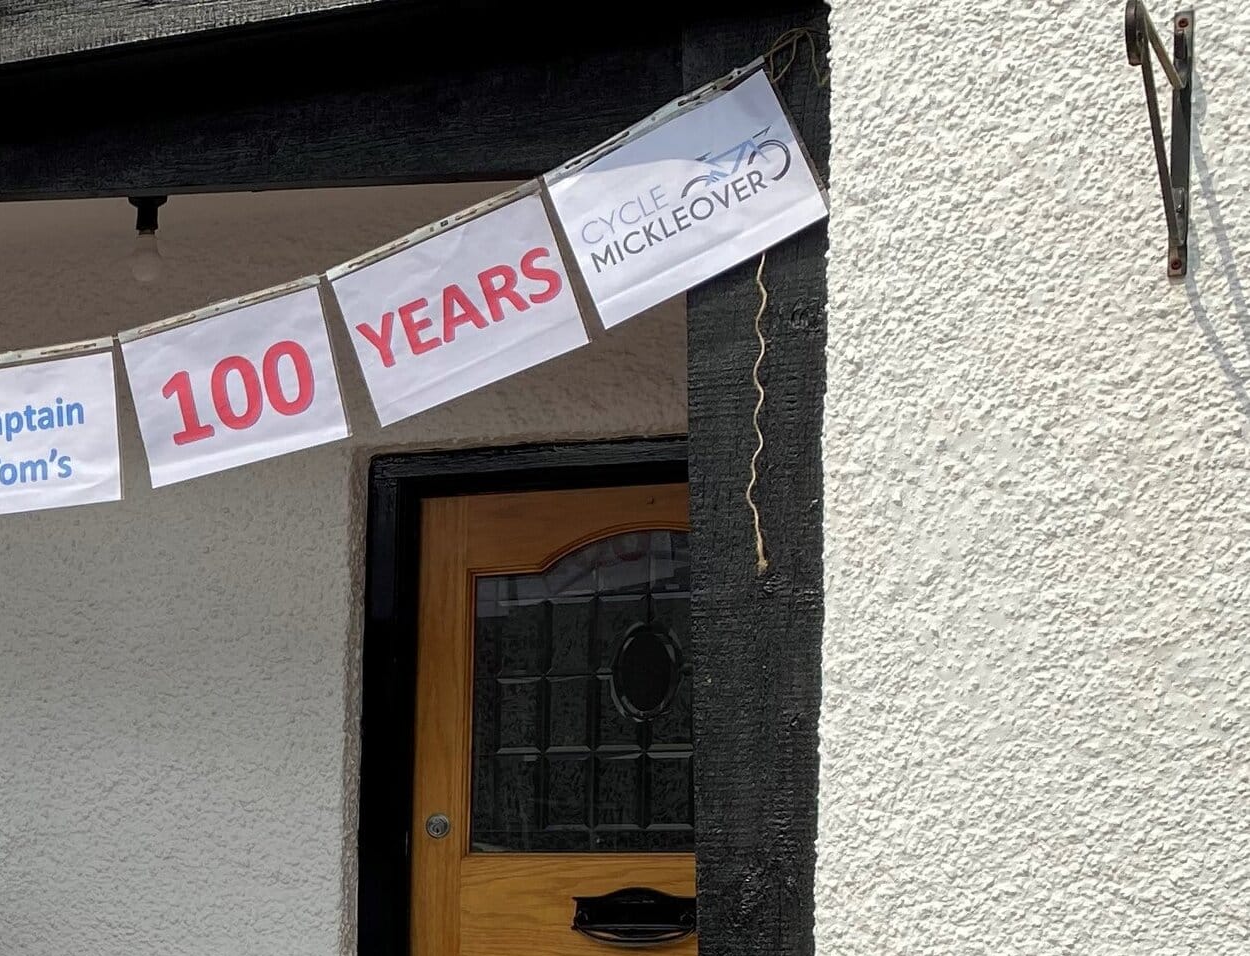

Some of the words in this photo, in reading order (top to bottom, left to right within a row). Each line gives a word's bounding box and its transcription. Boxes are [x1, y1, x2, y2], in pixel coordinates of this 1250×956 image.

[580, 183, 669, 246] CYCLE
[590, 168, 769, 274] MICKLEOVER
[161, 339, 315, 446] 100
[355, 247, 563, 368] YEARS
